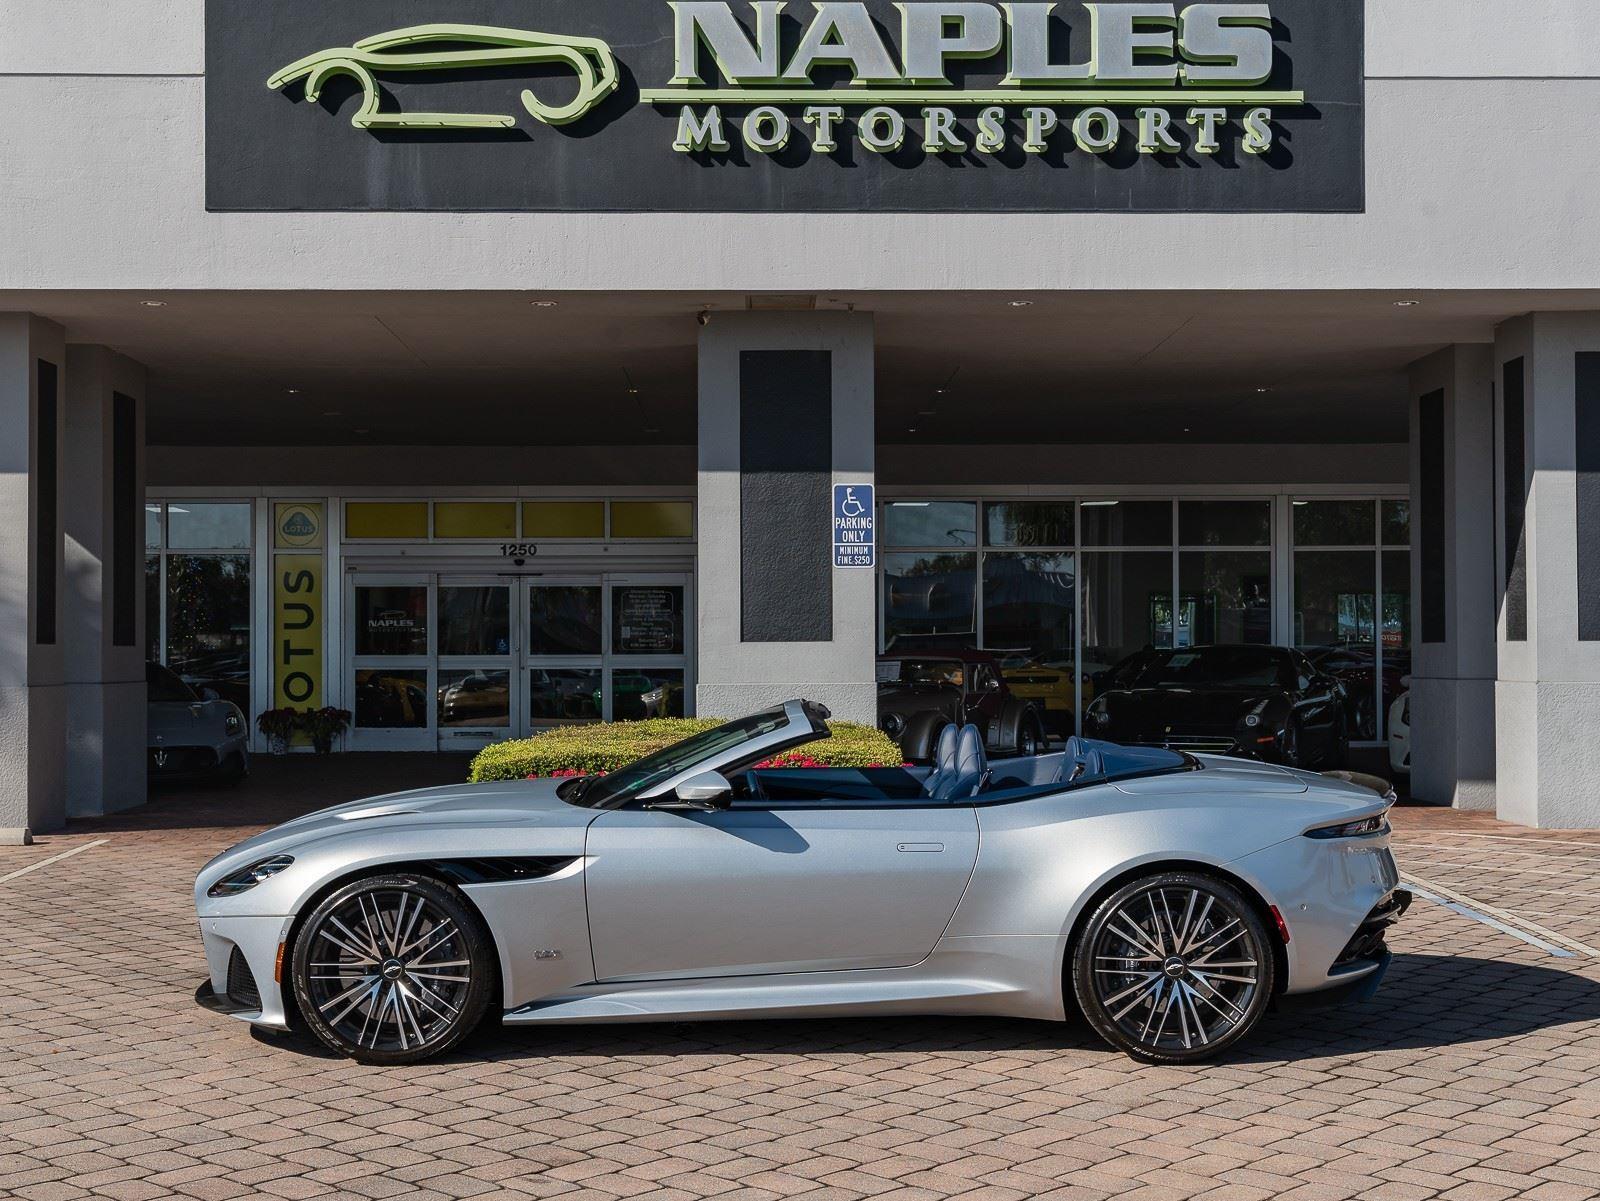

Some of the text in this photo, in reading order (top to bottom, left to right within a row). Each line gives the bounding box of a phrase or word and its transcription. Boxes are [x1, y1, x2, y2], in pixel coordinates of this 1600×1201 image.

[666, 1, 1273, 86] NAPLES
[672, 106, 1275, 155] MOTORSPORTS
[835, 517, 872, 529] PARKING
[842, 530, 865, 542] ONLY
[500, 544, 537, 556] 1250
[839, 546, 868, 555] MINIMUM
[837, 555, 870, 565] FINE $250
[368, 619, 414, 627] NAPLES
[283, 569, 315, 714] OTUS
